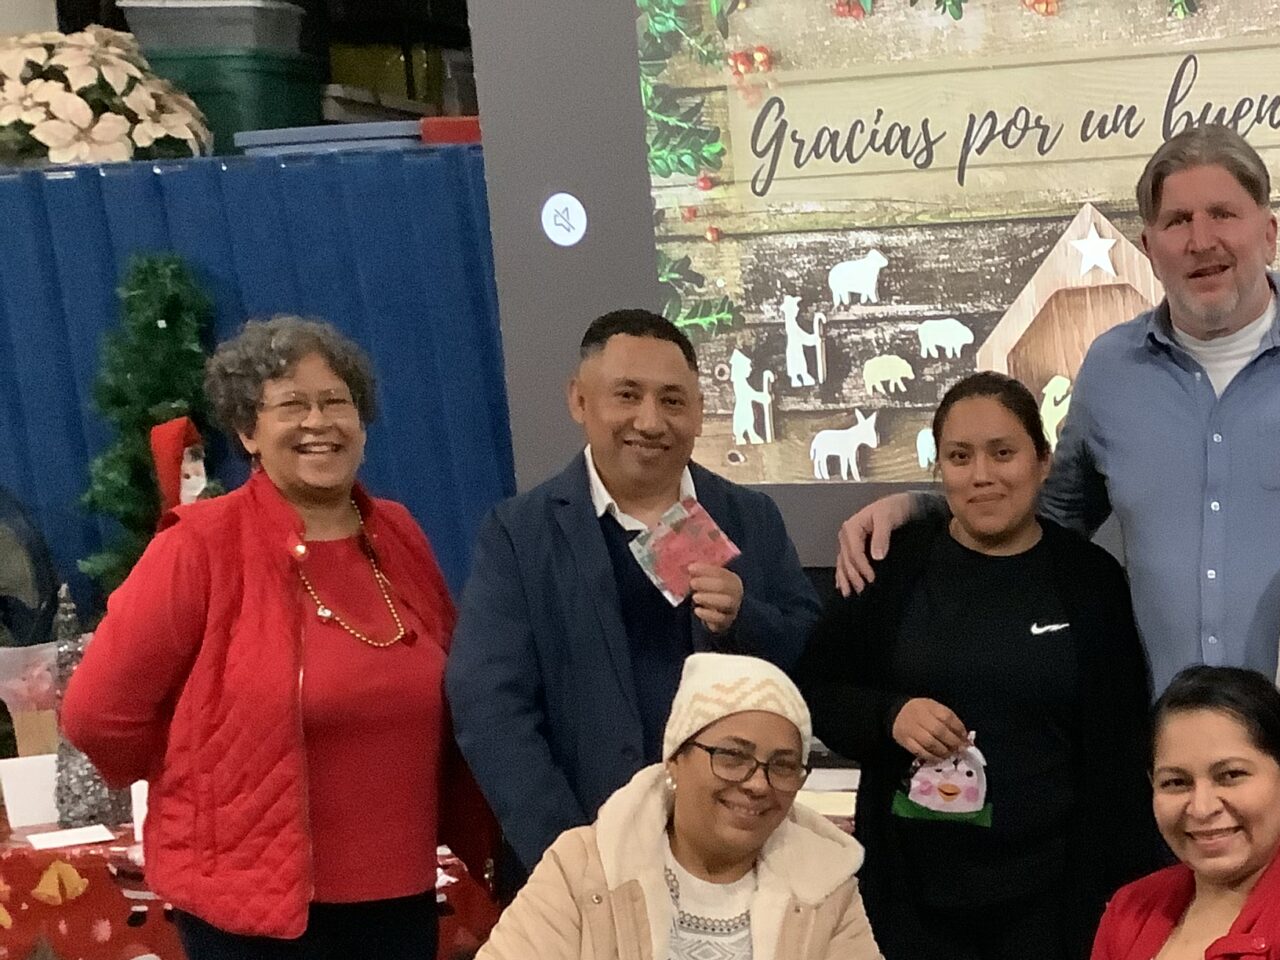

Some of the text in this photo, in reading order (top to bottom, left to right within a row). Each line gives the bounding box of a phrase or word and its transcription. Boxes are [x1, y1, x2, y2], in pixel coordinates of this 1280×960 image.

[751, 96, 947, 197] Gracias
[957, 106, 1064, 187] por
[1081, 103, 1146, 143] un
